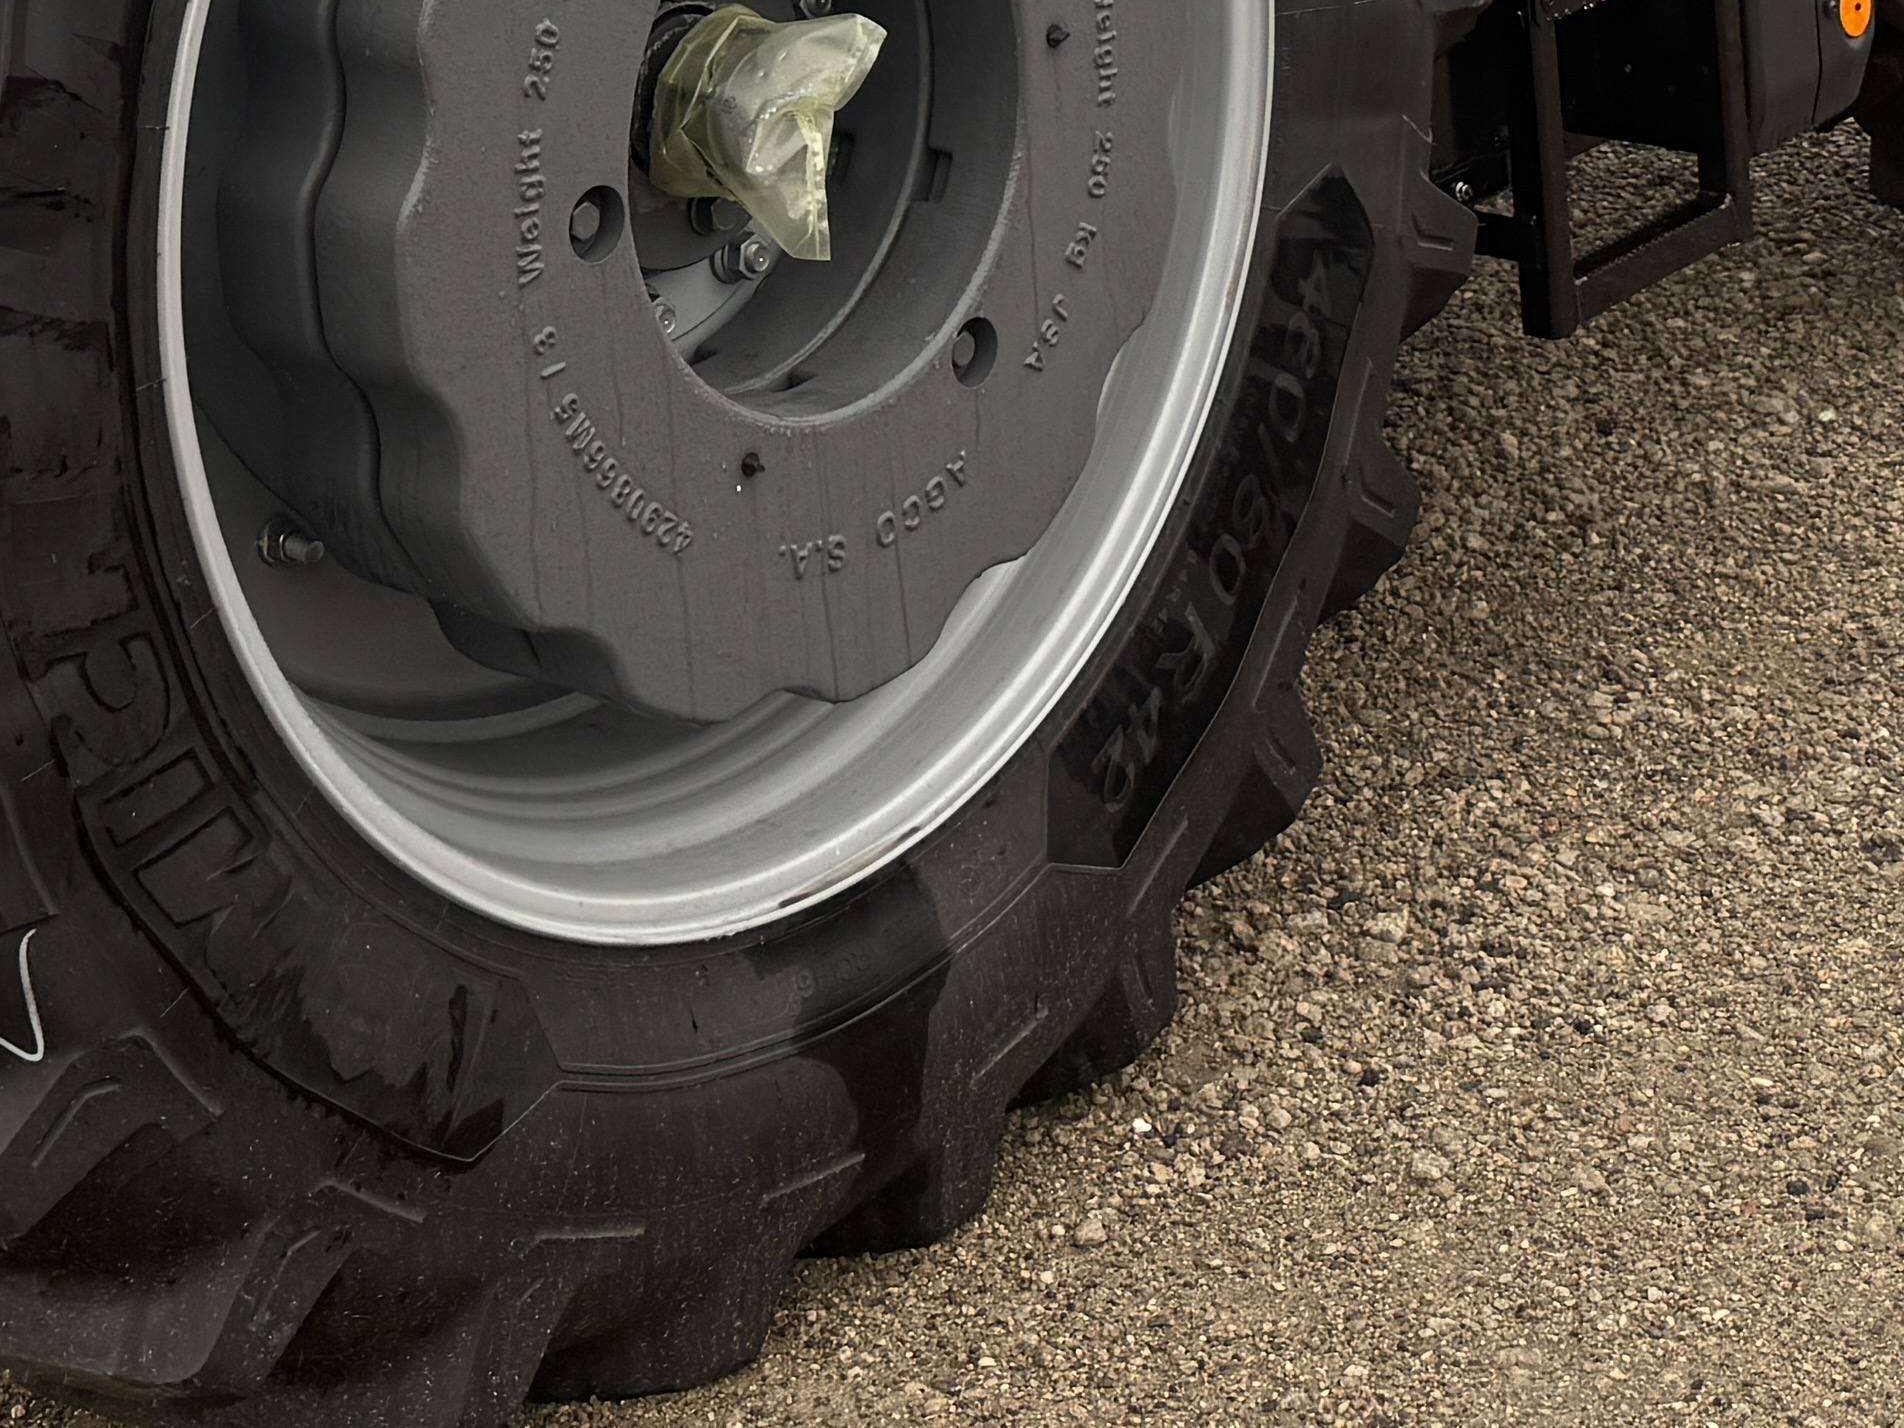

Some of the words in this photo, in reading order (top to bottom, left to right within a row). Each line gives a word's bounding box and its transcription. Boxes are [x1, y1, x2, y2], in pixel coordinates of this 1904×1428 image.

[522, 16, 561, 101] 250
[513, 126, 546, 286] Weight
[1087, 128, 1113, 199] 250
[549, 391, 695, 554] 4290866M5
[876, 448, 967, 547] AGCO
